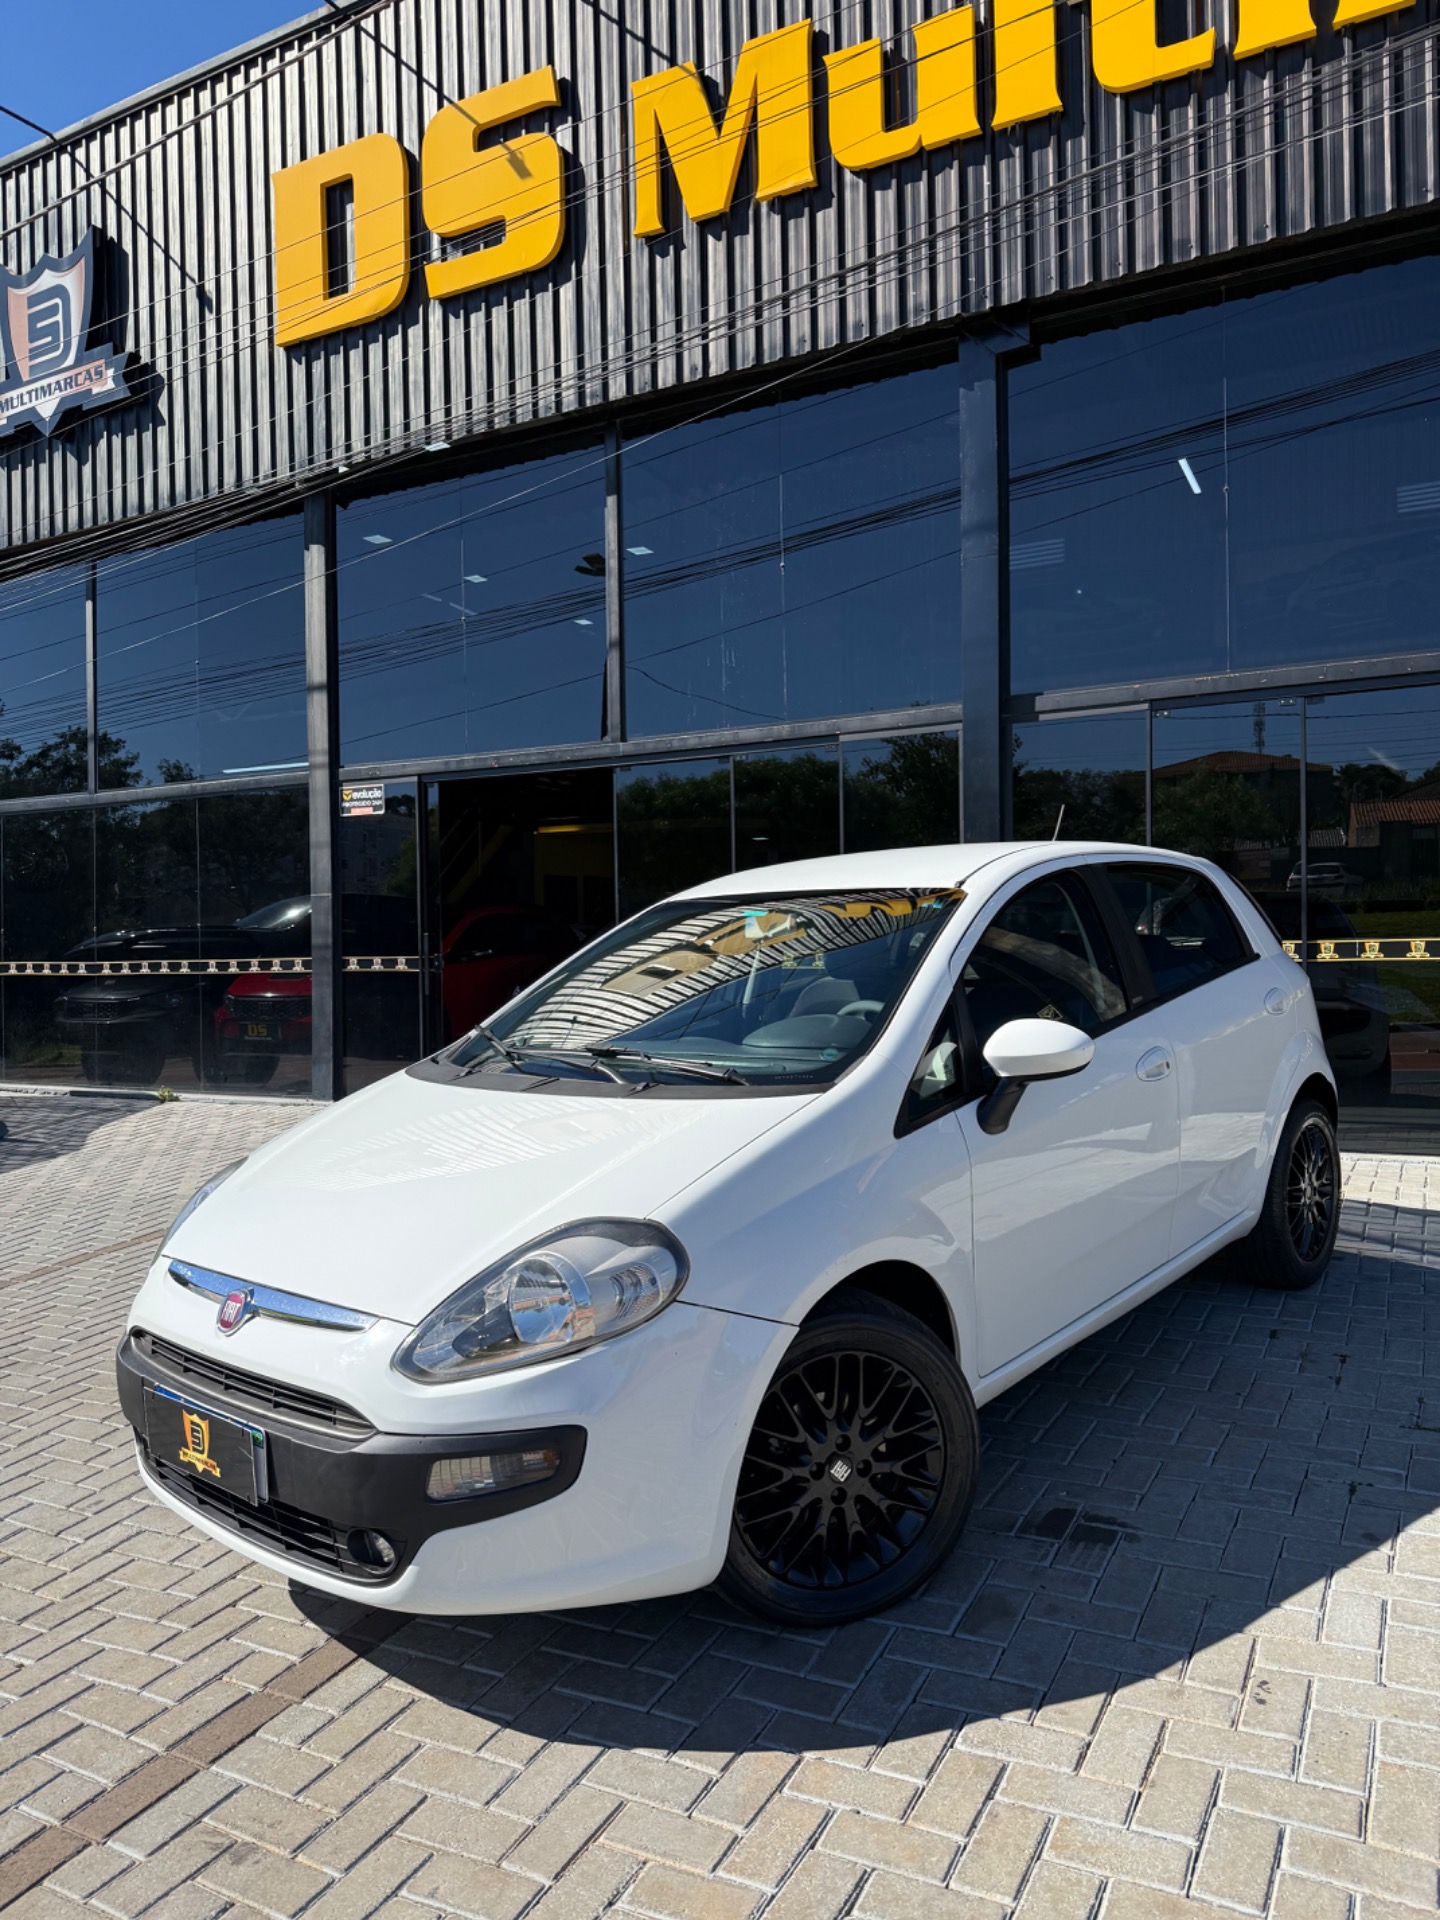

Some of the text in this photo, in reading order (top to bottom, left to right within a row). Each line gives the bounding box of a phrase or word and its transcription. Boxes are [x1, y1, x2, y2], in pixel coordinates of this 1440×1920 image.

[271, 65, 567, 348] DS
[0, 364, 104, 414] MULTIMARCAS
[220, 1300, 242, 1323] FIAT
